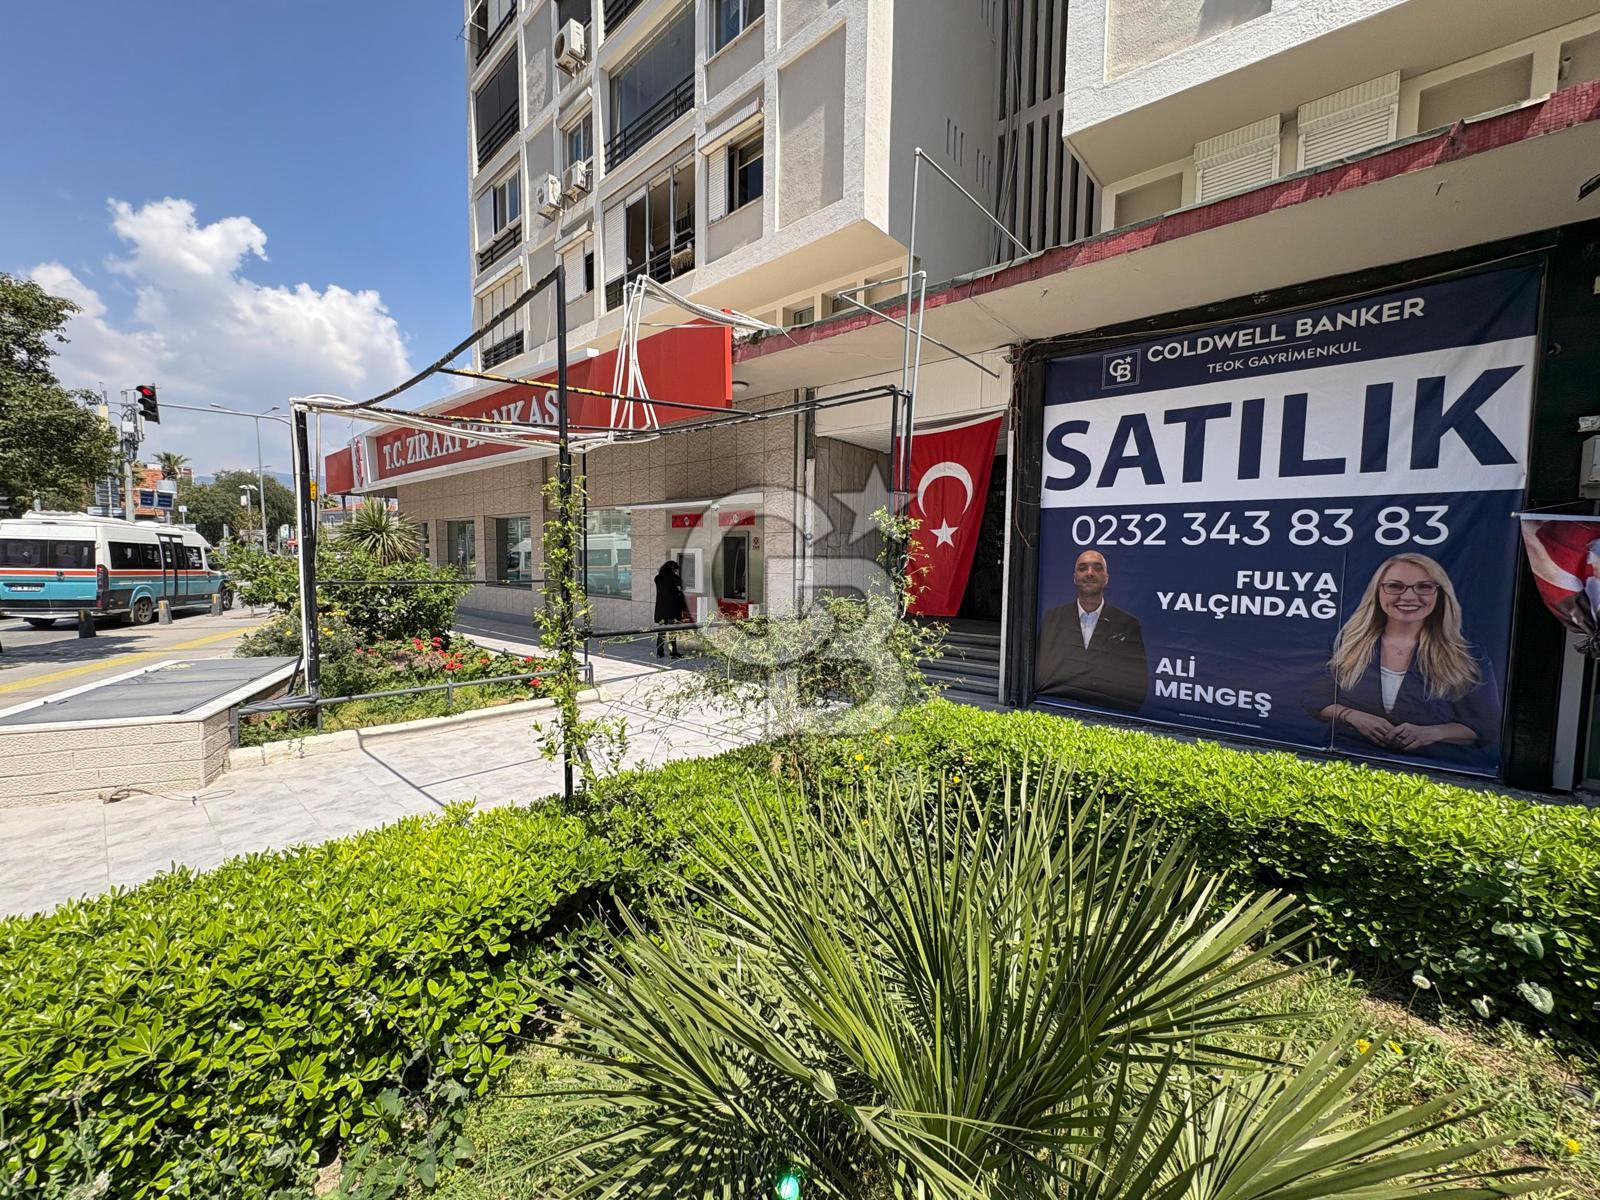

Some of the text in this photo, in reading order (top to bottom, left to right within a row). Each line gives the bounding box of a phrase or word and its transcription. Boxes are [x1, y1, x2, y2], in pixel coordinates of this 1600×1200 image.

[1147, 297, 1425, 363] COLDWELL BANKER
[1206, 341, 1362, 374] TEOK GAYRİMENKUL
[383, 440, 406, 470] T.C.
[467, 390, 571, 448] BANKAS
[1044, 364, 1525, 491] SATILIK
[1071, 505, 1450, 546] 0232 343 83 83
[1236, 570, 1338, 593] FULYA
[1156, 592, 1337, 620] YALÇINDAĞ
[1155, 655, 1196, 678] ALİ
[1155, 679, 1272, 718] MENGEŞ
